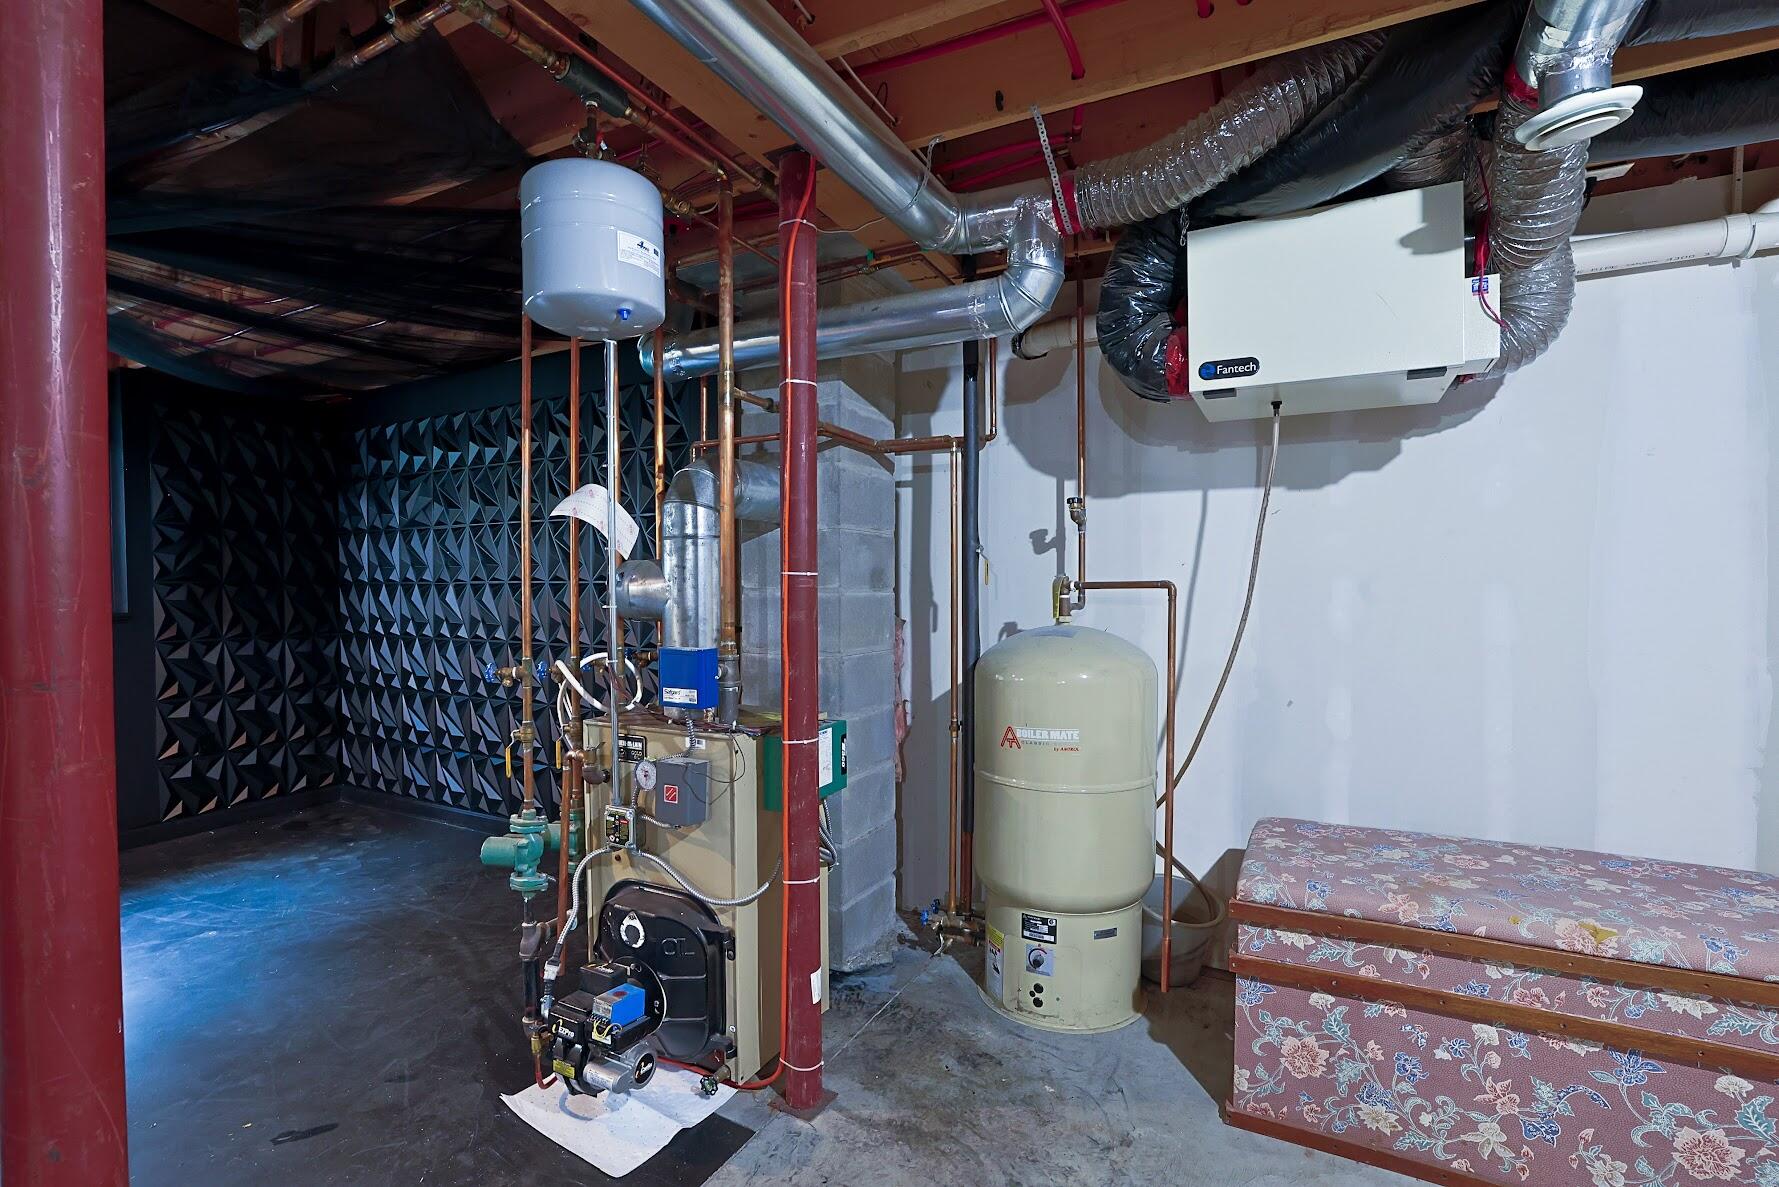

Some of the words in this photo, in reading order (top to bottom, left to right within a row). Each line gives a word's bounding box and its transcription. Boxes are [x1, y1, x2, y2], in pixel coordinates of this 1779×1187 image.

[1216, 362, 1257, 375] Fantech
[1016, 728, 1049, 740] BOILER
[1049, 730, 1080, 740] MATE
